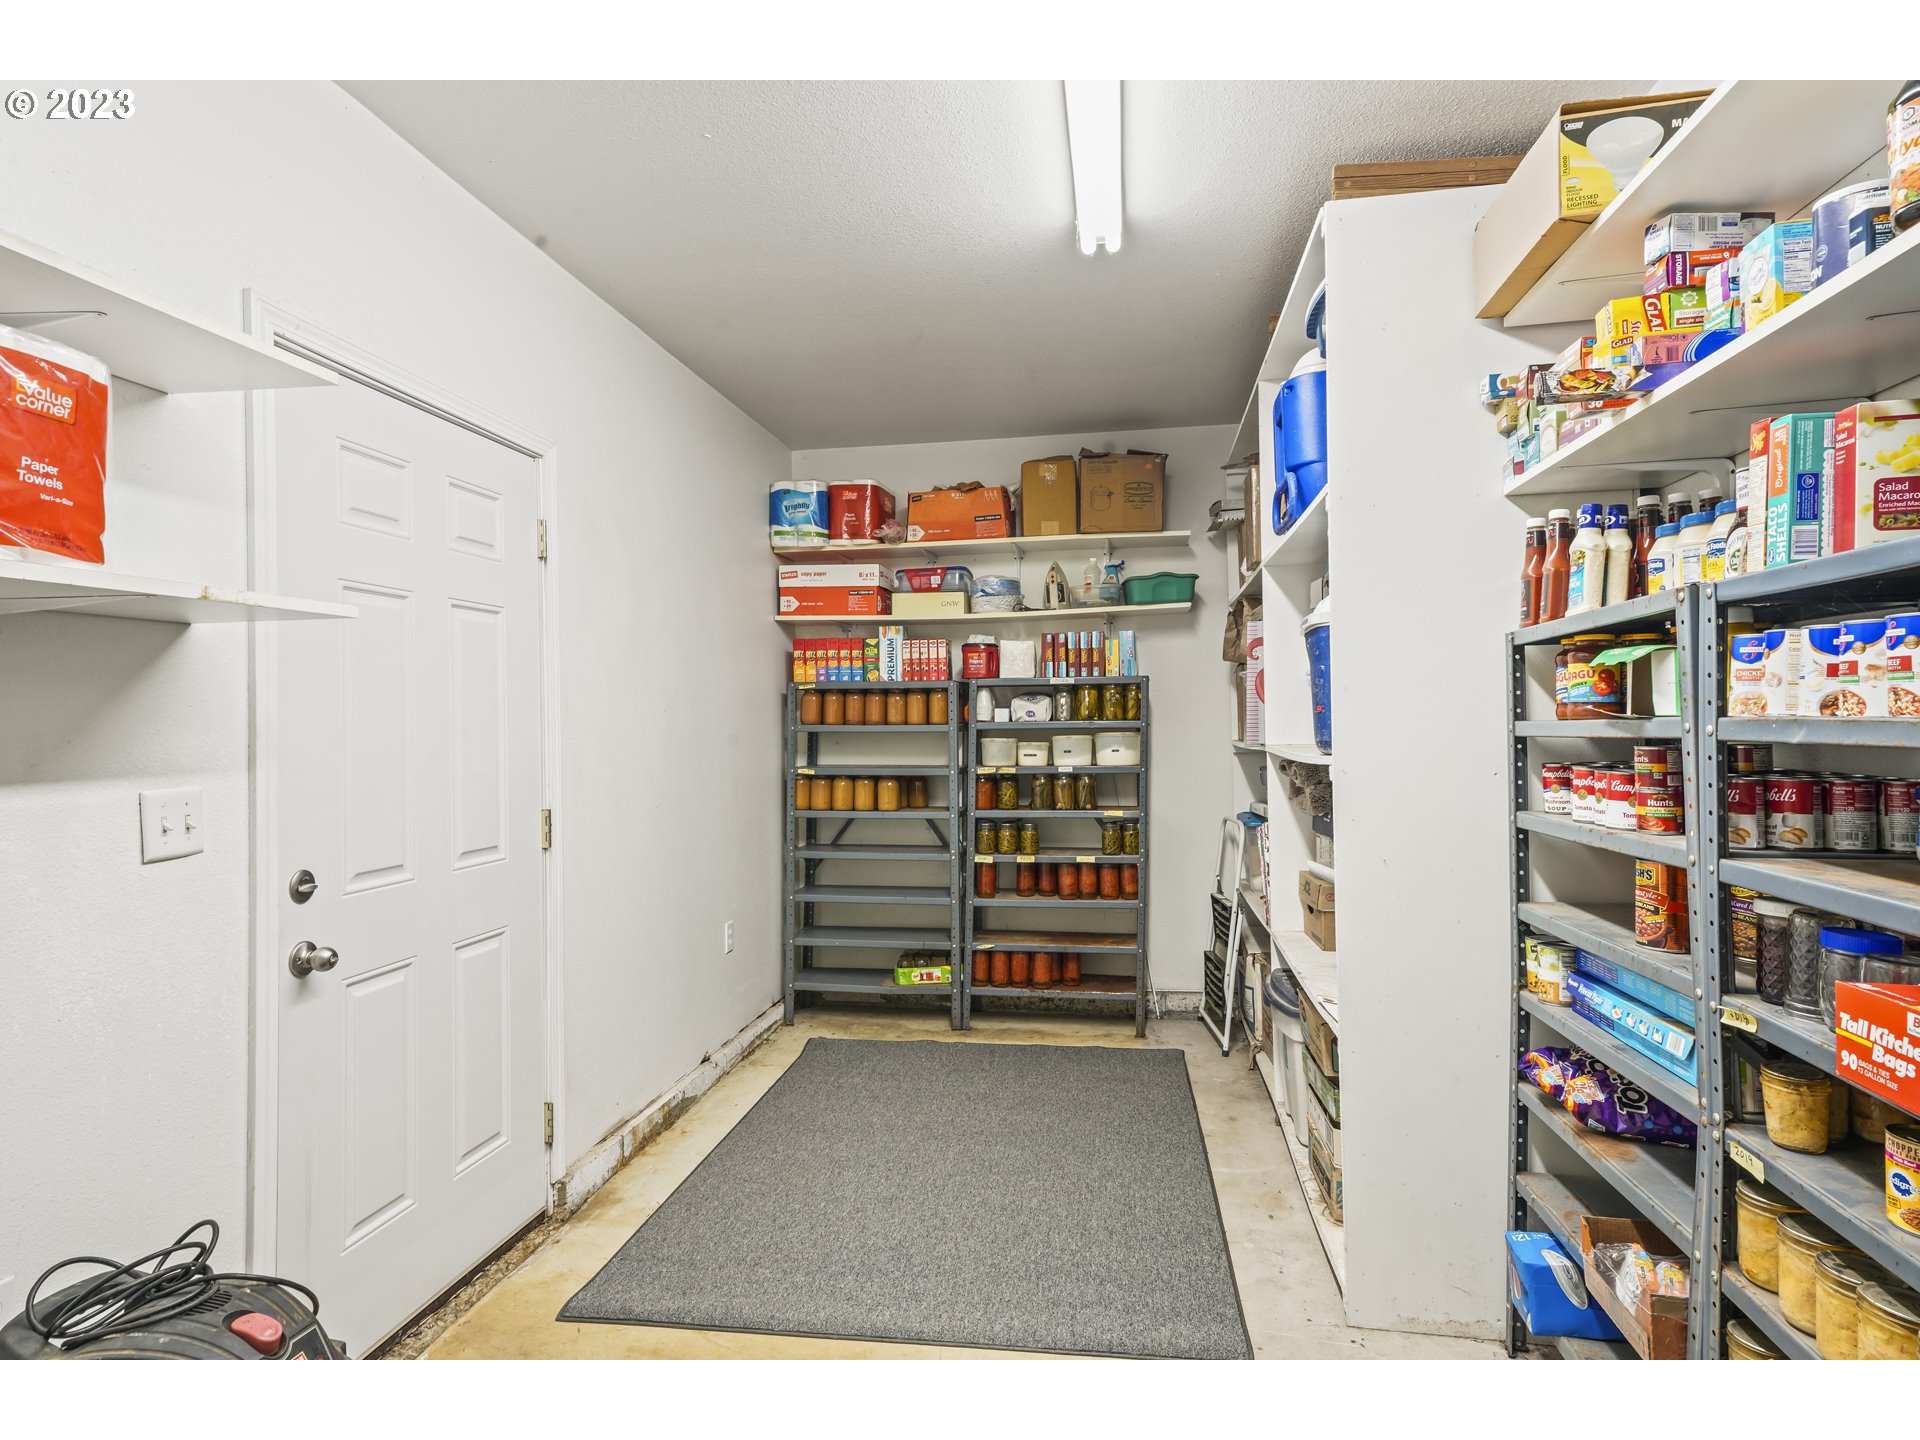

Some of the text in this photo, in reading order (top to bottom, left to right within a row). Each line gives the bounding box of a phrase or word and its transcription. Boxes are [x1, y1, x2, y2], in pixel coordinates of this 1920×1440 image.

[1566, 193, 1599, 203] RECESSED
[1566, 200, 1598, 209] LIGHTING
[1612, 337, 1634, 348] GLAD
[16, 393, 71, 420] corner
[1587, 400, 1604, 409] 30
[21, 456, 59, 476] Paper
[1775, 448, 1784, 489] Original
[16, 469, 64, 491] Towels
[1878, 481, 1909, 492] Salad
[39, 492, 74, 507] Vari-a-Size
[1878, 492, 1920, 502] Macaro
[1767, 506, 1778, 546] TACO
[1776, 502, 1788, 564] SHELLS
[941, 600, 960, 608] GNW
[887, 638, 896, 681] PREMIUM
[1736, 670, 1762, 678] CHICKE
[1839, 1011, 1920, 1063] Tall Kitche
[1841, 1050, 1858, 1071] 90
[1858, 1059, 1890, 1080] BAGS & TIES
[1872, 1043, 1917, 1078] Bags
[1857, 1066, 1898, 1092] 13 GALLON SIZE
[1734, 1146, 1754, 1167] 2019
[1887, 1137, 1920, 1158] CHOPPE
